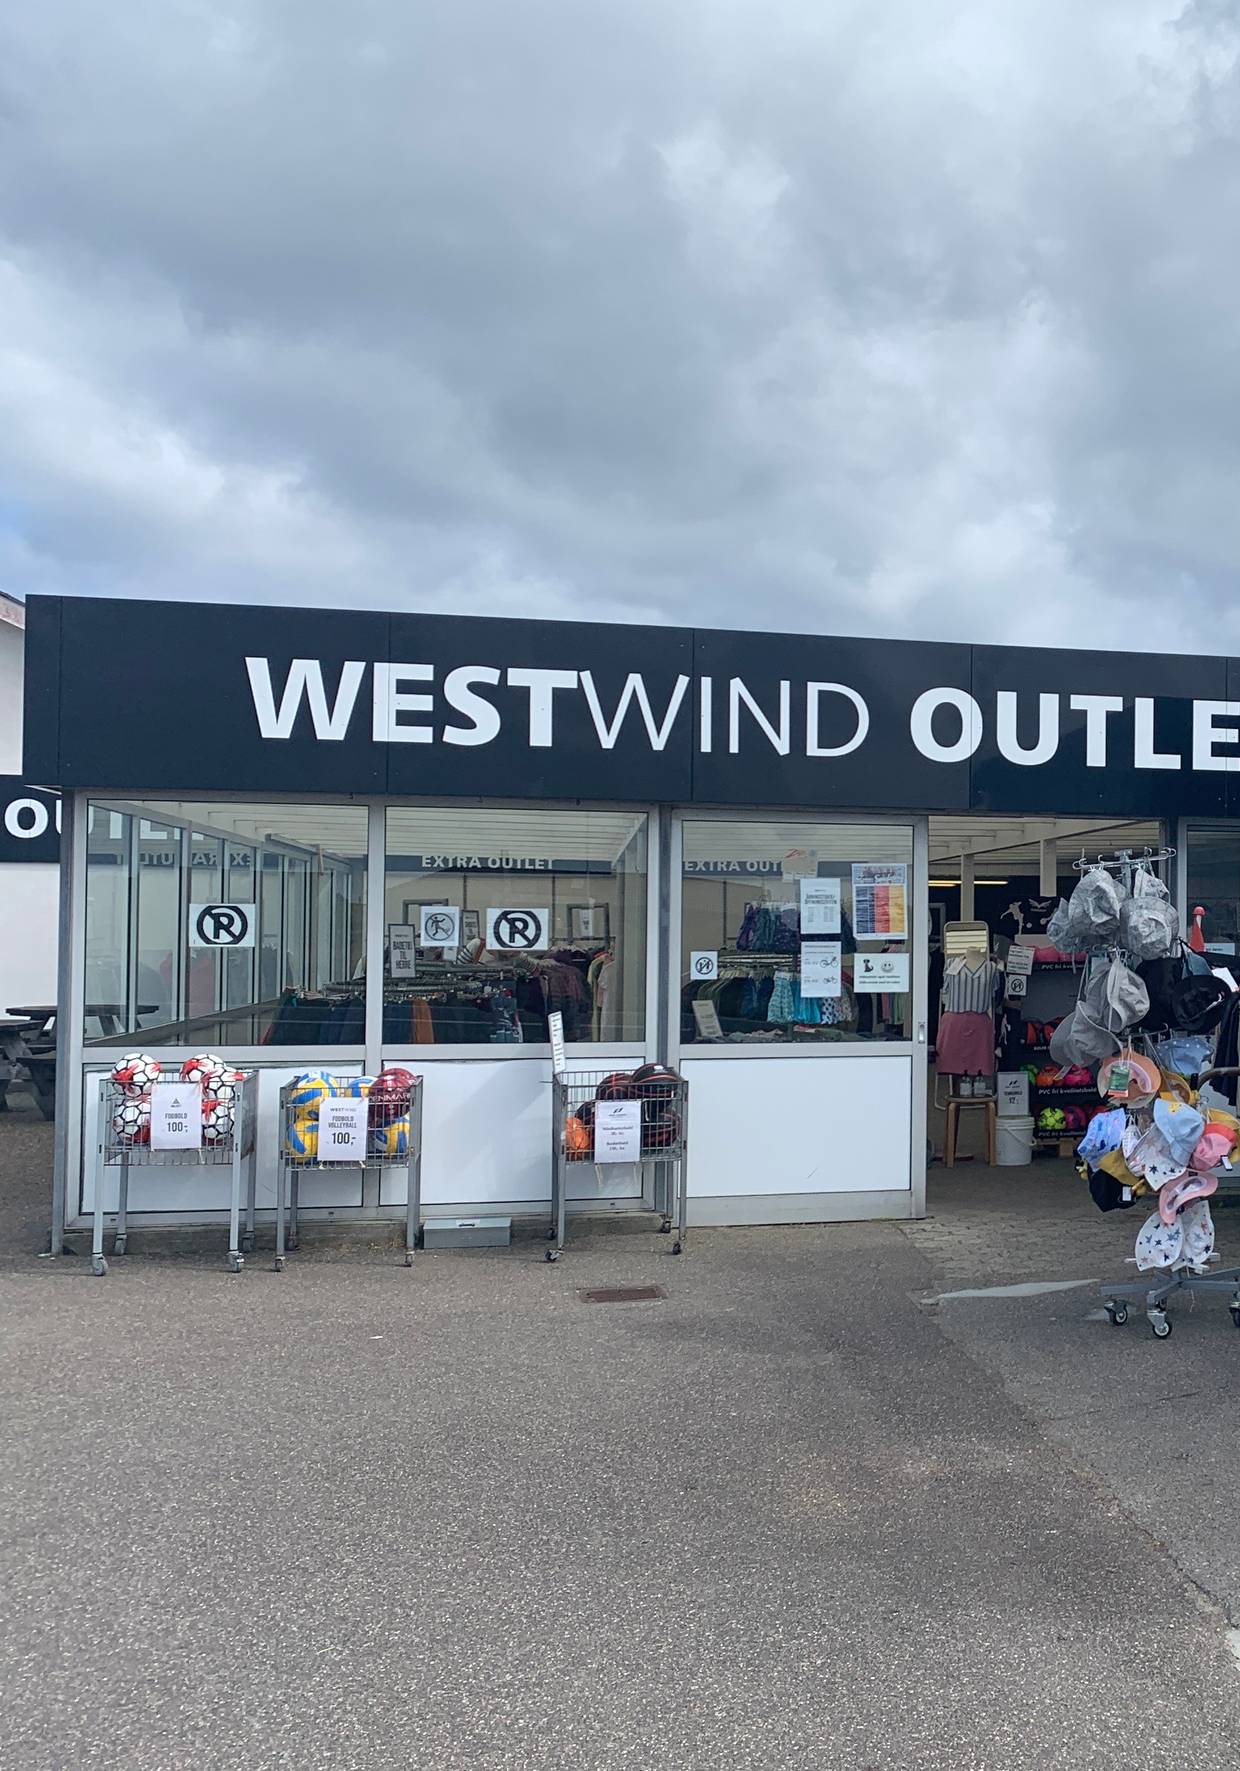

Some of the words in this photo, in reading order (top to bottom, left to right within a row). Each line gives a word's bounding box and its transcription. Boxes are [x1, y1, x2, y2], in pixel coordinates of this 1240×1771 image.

[421, 855, 481, 868] EXTRA
[488, 856, 555, 870] OUTLET
[684, 860, 741, 872] EXTRA
[746, 861, 783, 872] OUT
